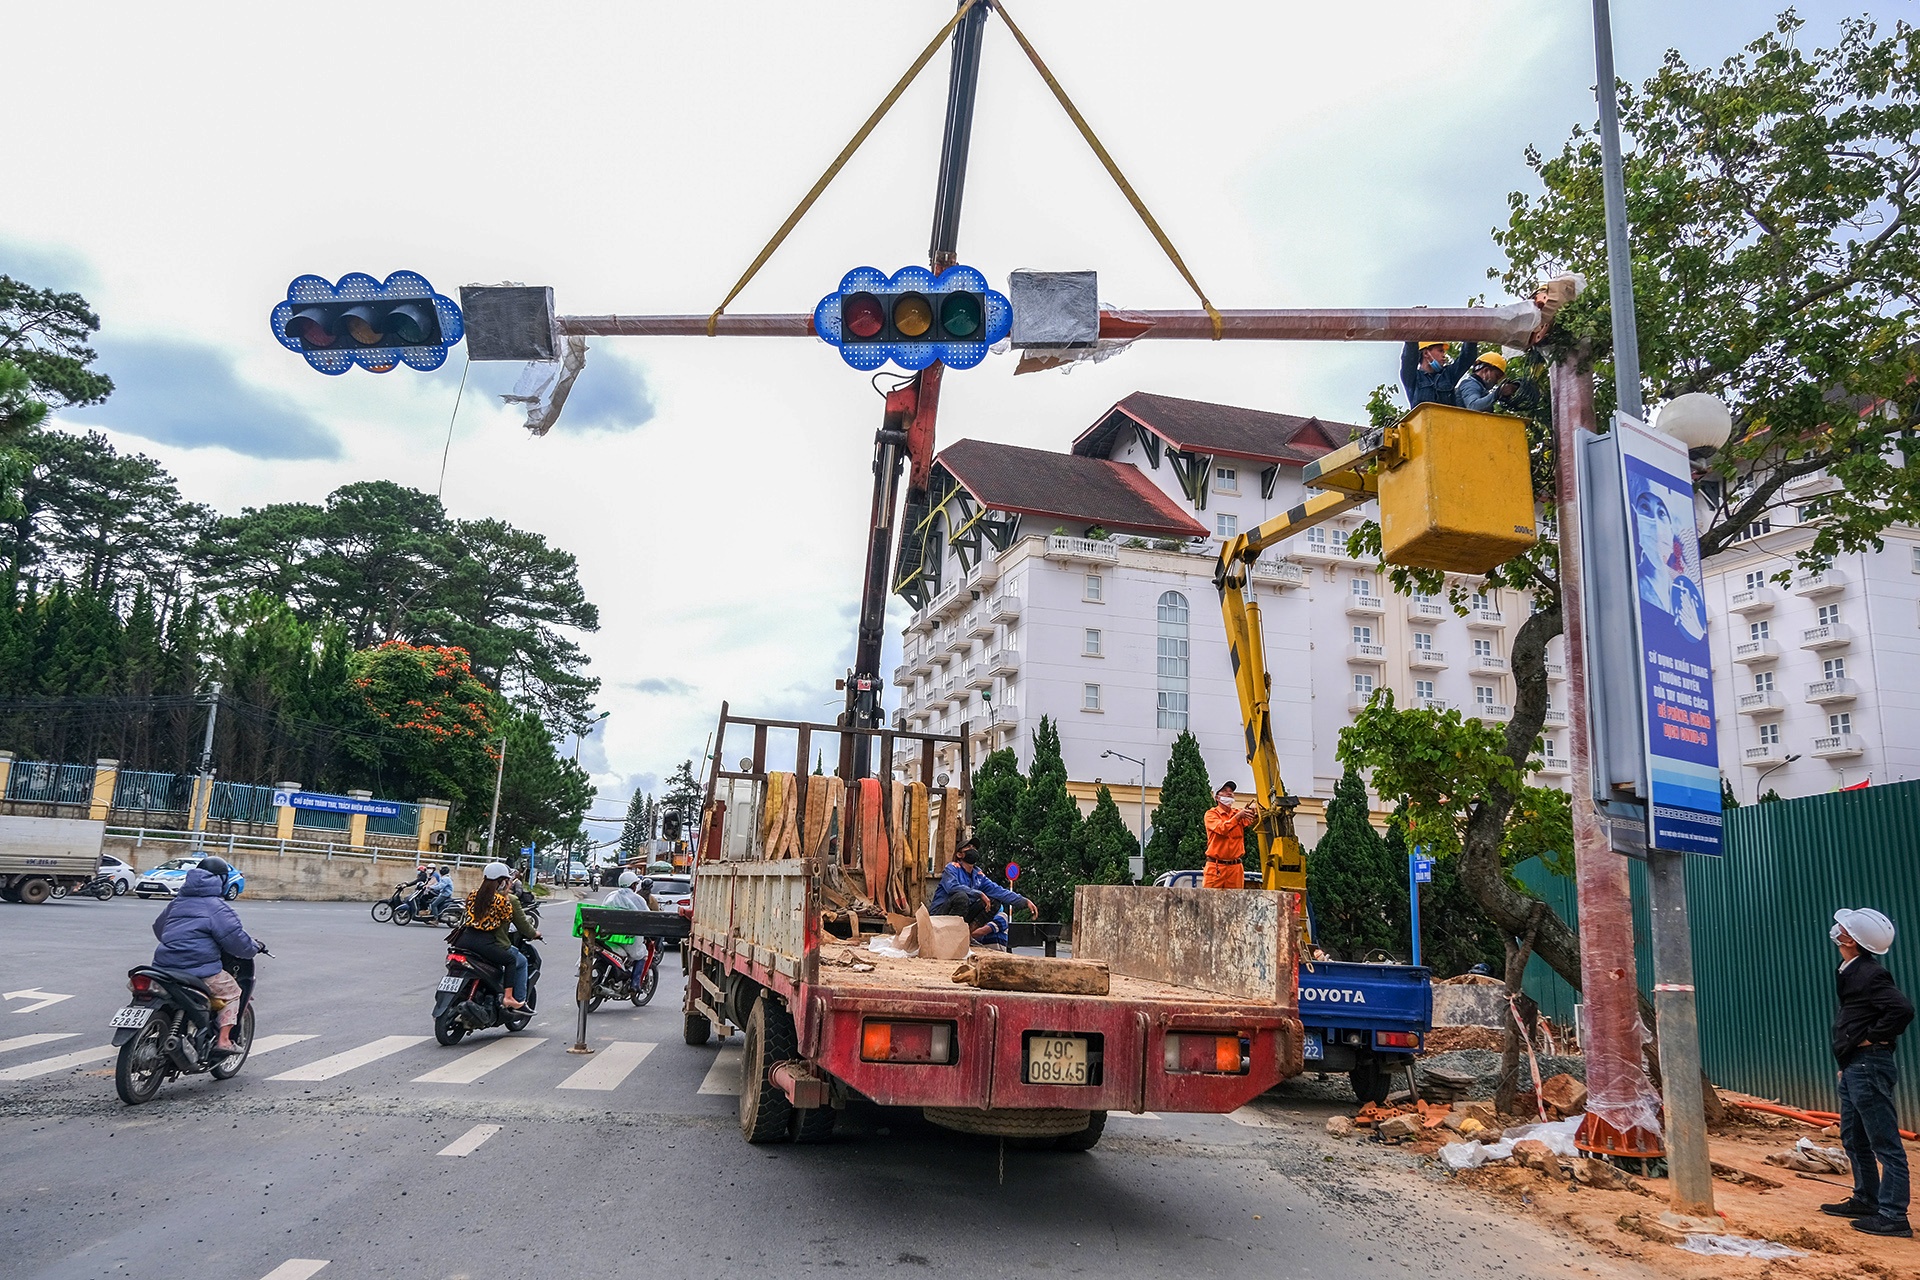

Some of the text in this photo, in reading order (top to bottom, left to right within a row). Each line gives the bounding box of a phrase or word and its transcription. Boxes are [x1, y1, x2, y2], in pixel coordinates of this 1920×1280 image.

[1680, 727, 1708, 746] COVID-19
[1044, 1040, 1074, 1060] 49C
[1031, 1061, 1085, 1082] 089.45
